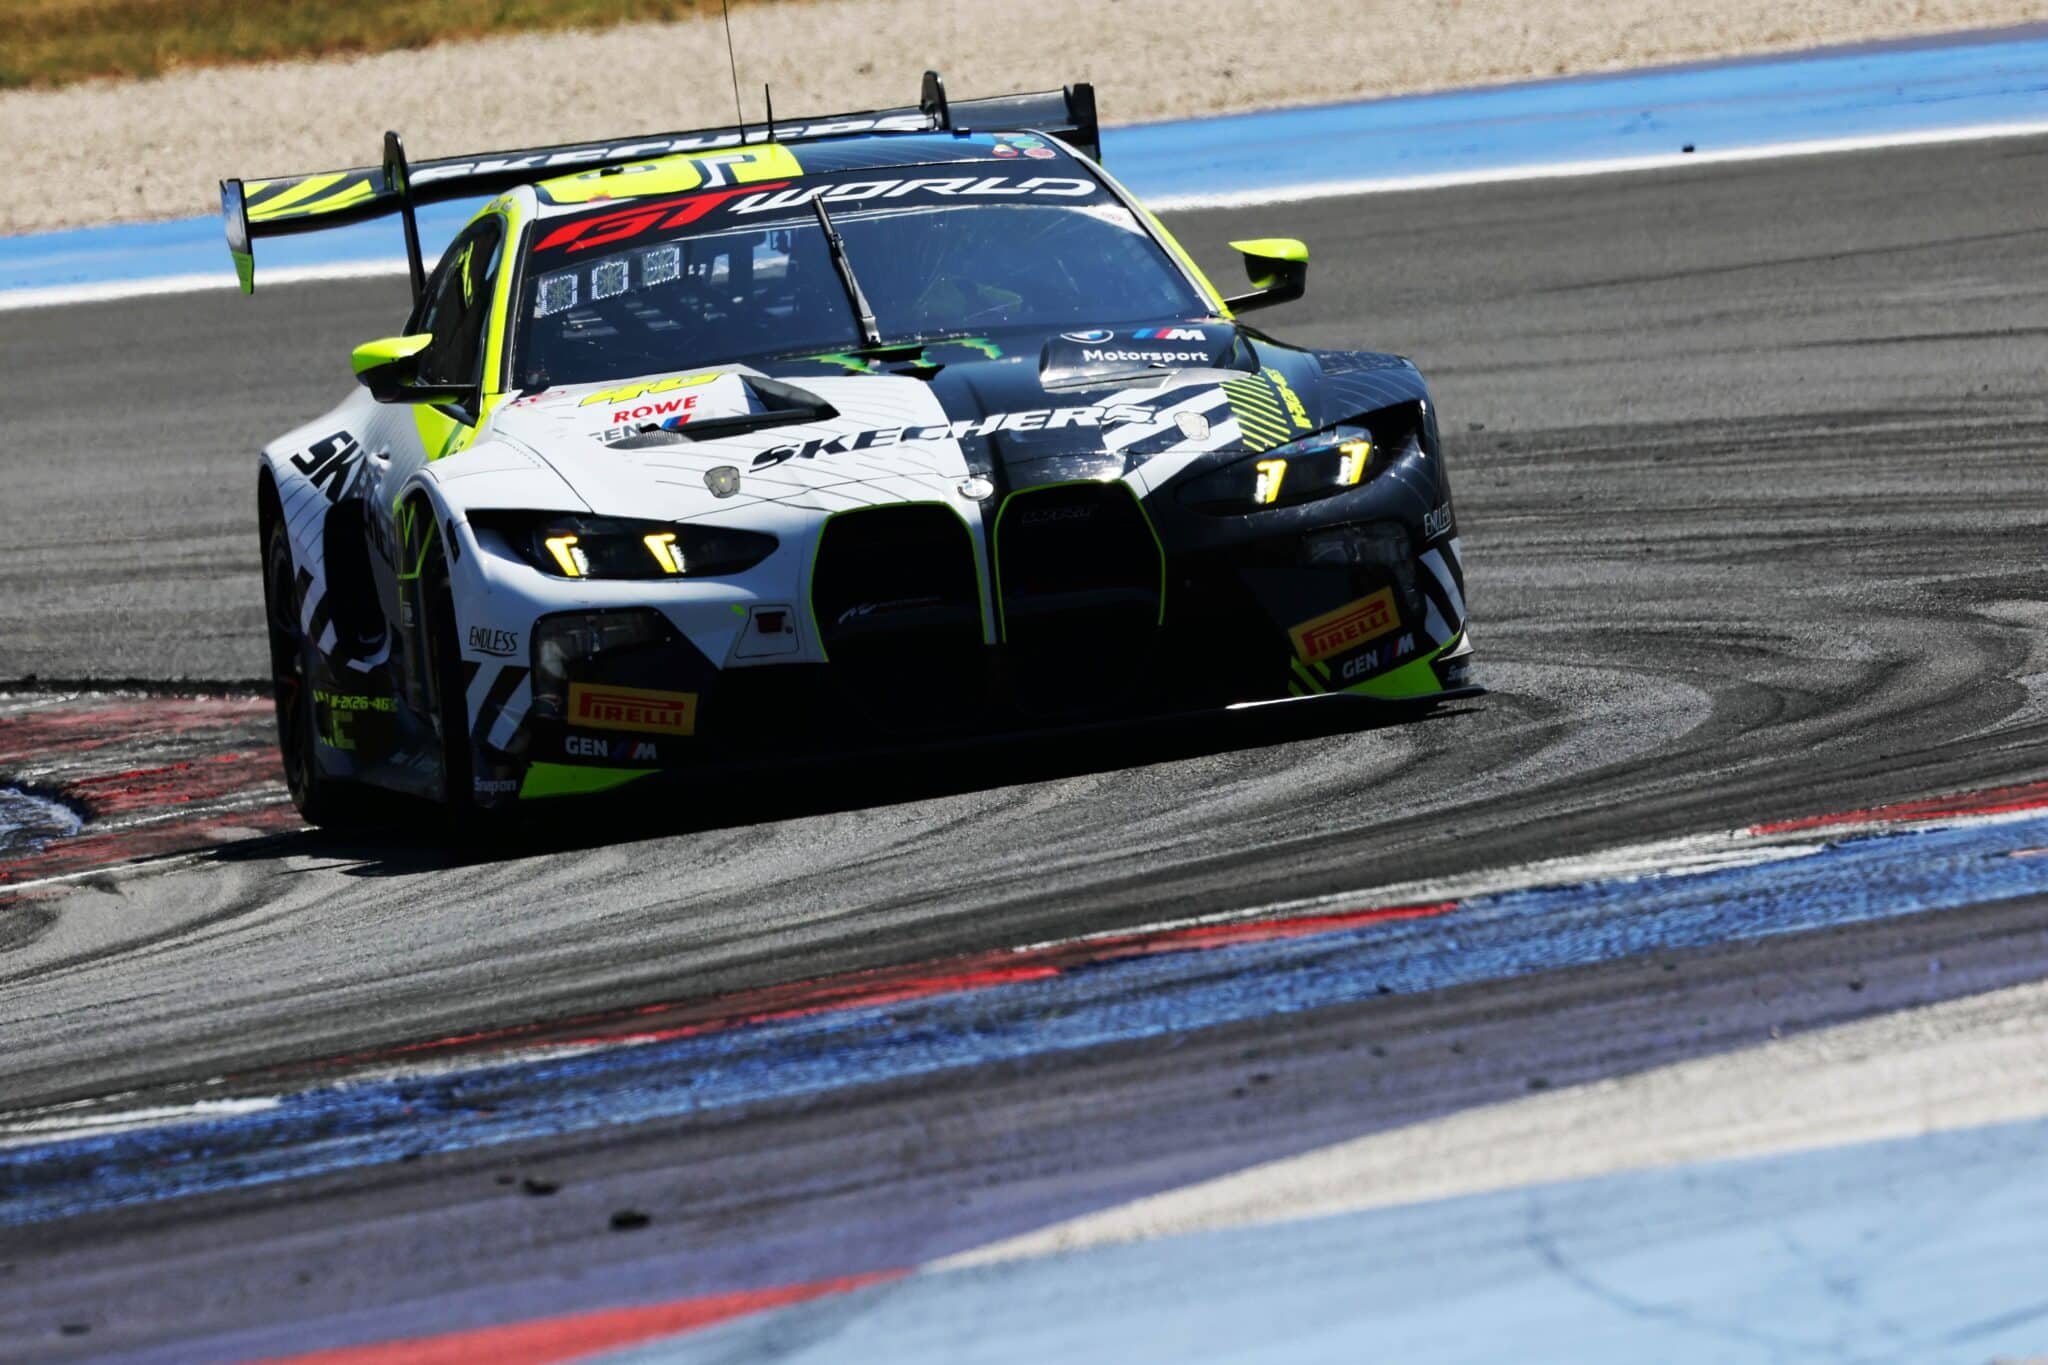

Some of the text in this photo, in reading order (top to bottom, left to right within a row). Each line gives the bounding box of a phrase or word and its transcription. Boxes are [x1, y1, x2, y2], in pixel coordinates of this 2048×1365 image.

[728, 177, 1096, 214] WORLD
[1082, 349, 1209, 363] Motorsport
[613, 395, 699, 423] ROWE
[749, 403, 1162, 473] SKECHERS
[469, 626, 518, 652] ENDLESS
[1302, 600, 1391, 657] PIRELLI
[1342, 650, 1379, 680] GEN
[579, 693, 685, 727] PIRELLI
[565, 736, 608, 757] GEN
